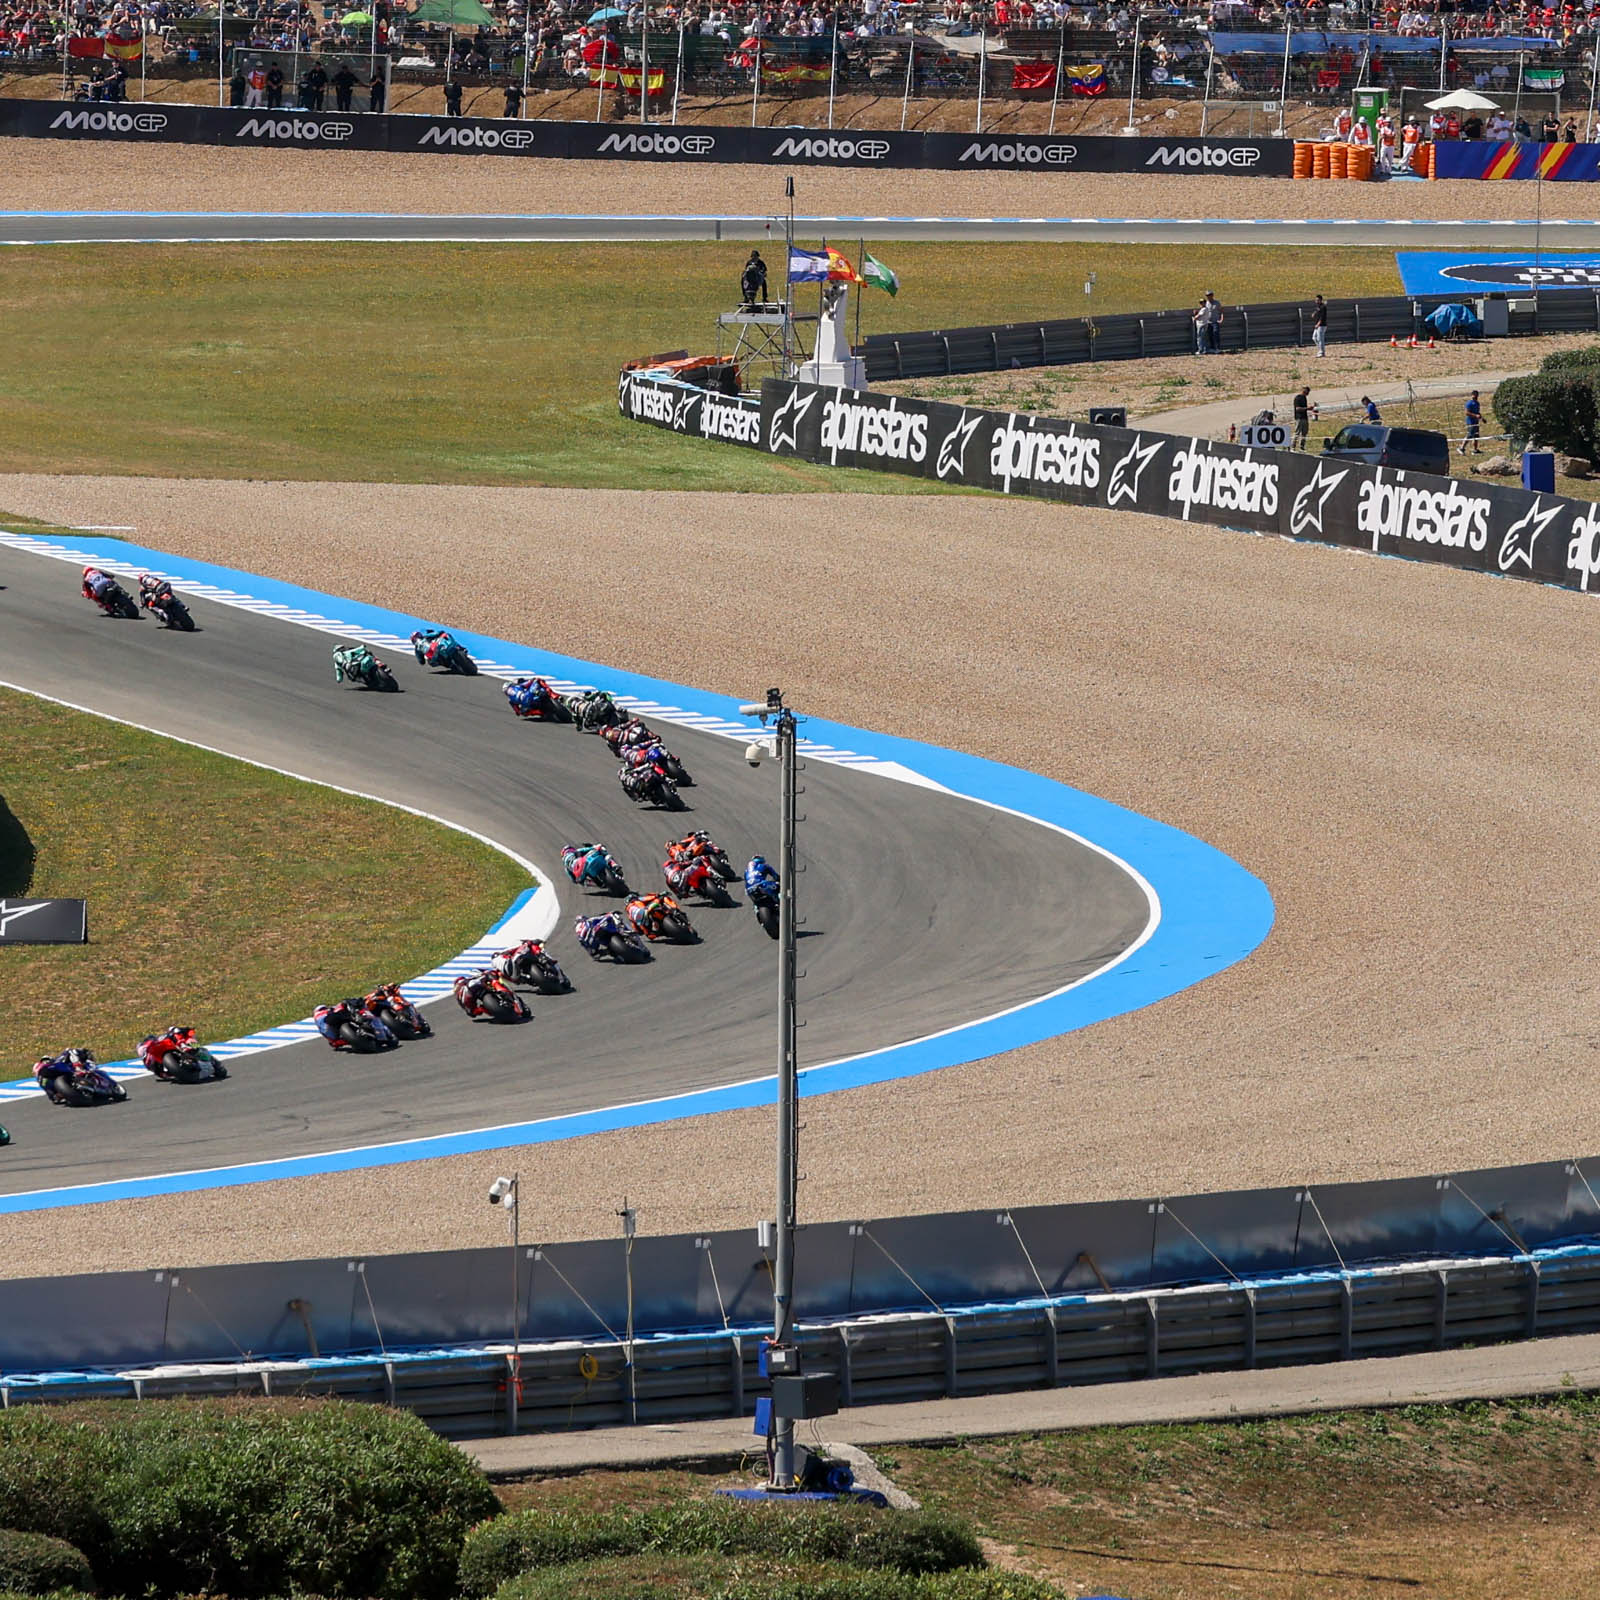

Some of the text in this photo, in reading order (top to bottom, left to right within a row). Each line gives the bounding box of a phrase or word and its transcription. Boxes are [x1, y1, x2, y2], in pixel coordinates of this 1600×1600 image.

[50, 111, 167, 132] MotoGP
[236, 119, 353, 140] MotoGP
[418, 127, 534, 148] MotoGP
[597, 133, 715, 154] MotoGP
[772, 138, 889, 158] MotoGP
[959, 143, 1077, 163] MotoGP
[1146, 146, 1260, 166] MotoGP
[700, 394, 760, 444] alpinestars
[821, 387, 927, 465] alpinestars
[1241, 427, 1285, 446] 100
[991, 413, 1100, 493] alpinestars
[1168, 436, 1278, 520] alpinestars
[1357, 466, 1490, 551] alpinestars
